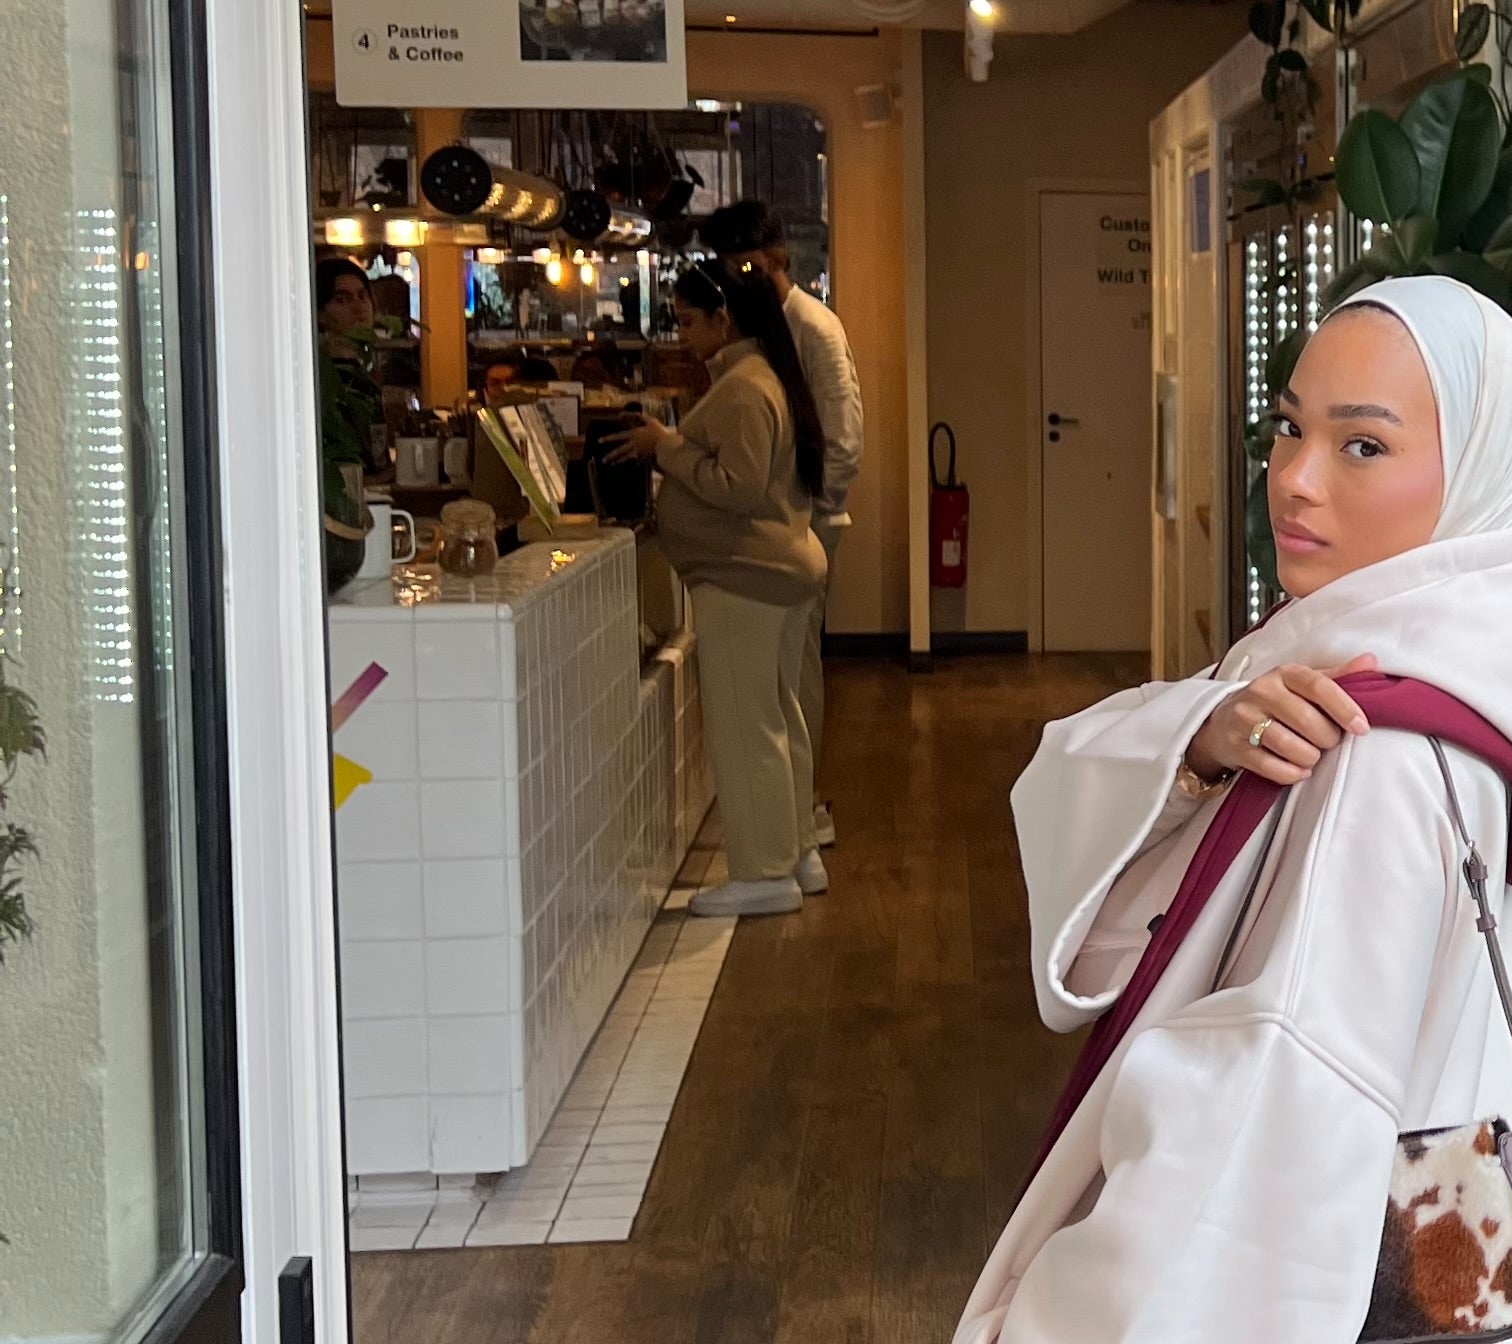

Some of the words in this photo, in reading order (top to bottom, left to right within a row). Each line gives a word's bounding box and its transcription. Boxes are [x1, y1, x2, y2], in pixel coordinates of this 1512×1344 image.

[387, 23, 459, 40] Pastries
[358, 33, 370, 50] 4
[388, 45, 400, 61] &
[406, 45, 464, 62] Coffee
[1097, 268, 1134, 284] Wild
